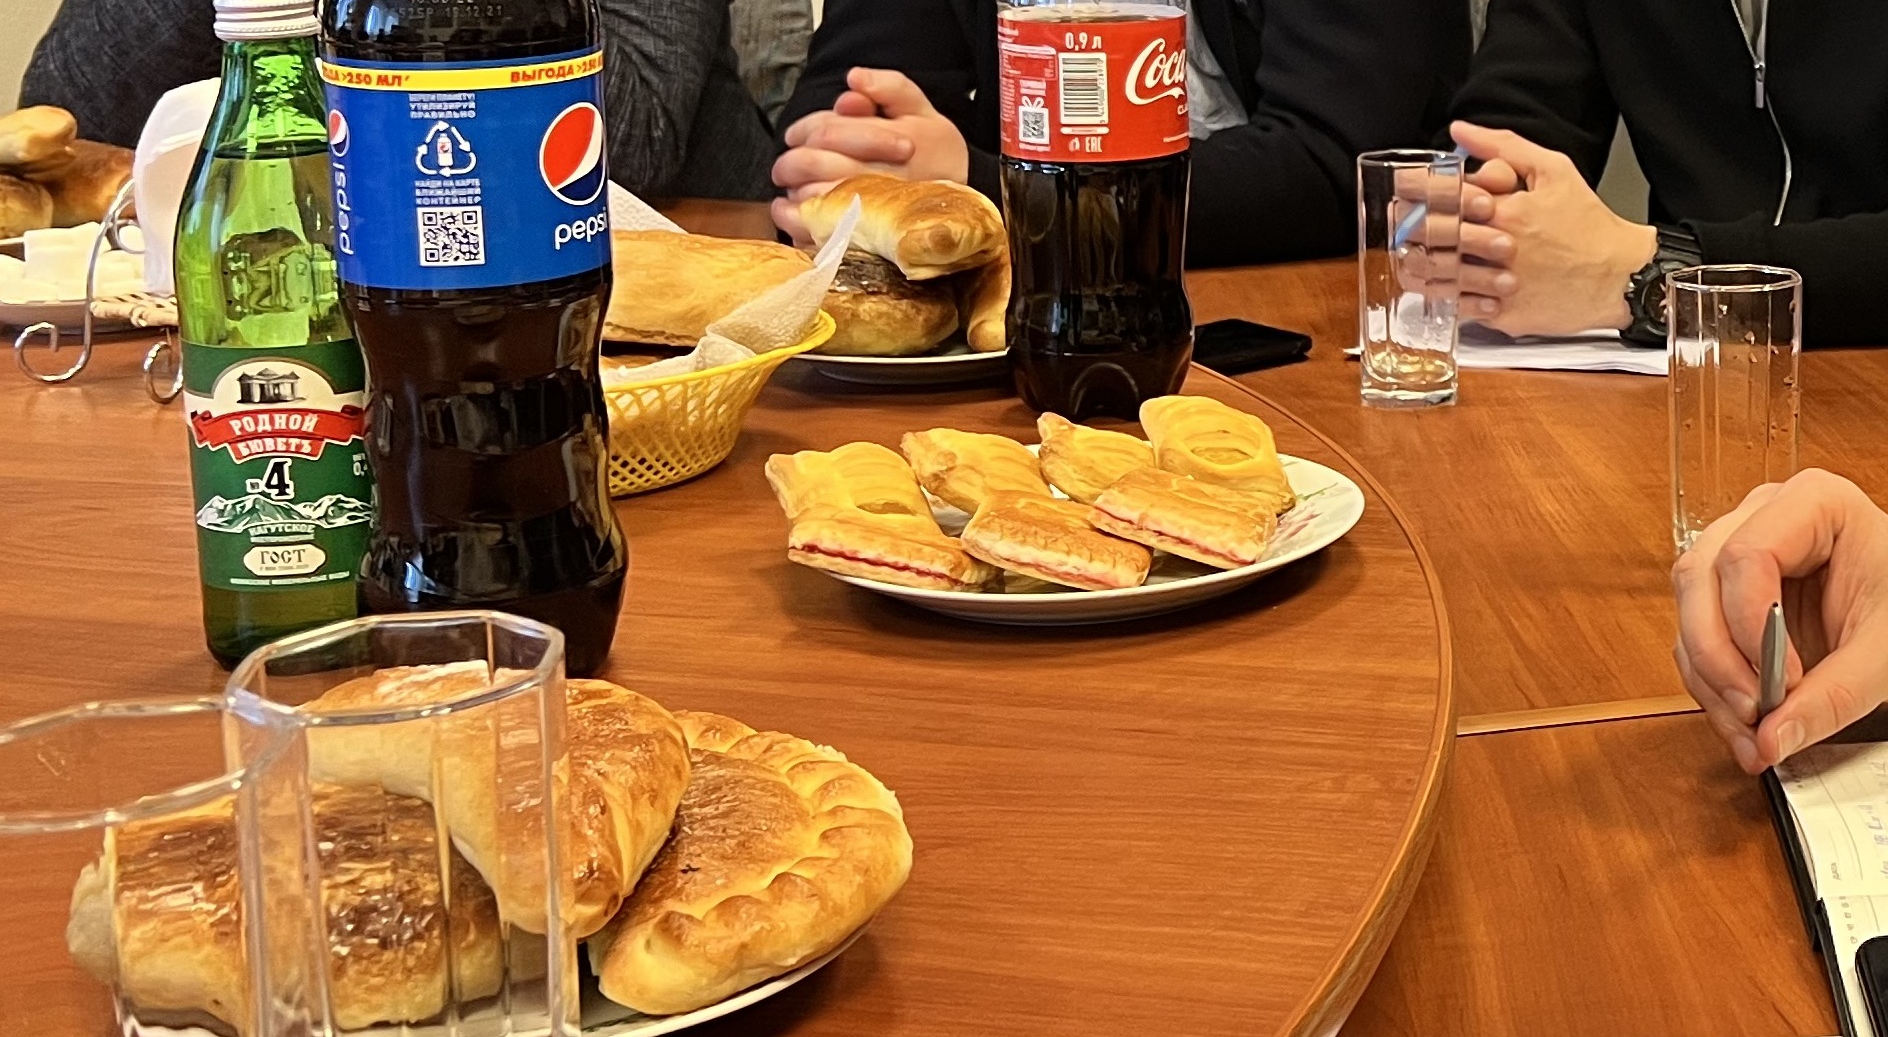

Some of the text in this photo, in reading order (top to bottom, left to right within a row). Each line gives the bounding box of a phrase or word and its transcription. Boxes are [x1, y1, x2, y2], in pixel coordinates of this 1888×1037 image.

[1065, 32, 1088, 51] 0,9
[510, 65, 575, 83] ВЫГОДА
[410, 110, 476, 119] ПРАВИЛЬНО
[332, 162, 354, 255] pepsi
[229, 413, 318, 436] РОДНОЙ
[236, 437, 312, 456] БЮВЕТЪ
[260, 548, 306, 564] ГОСТ
